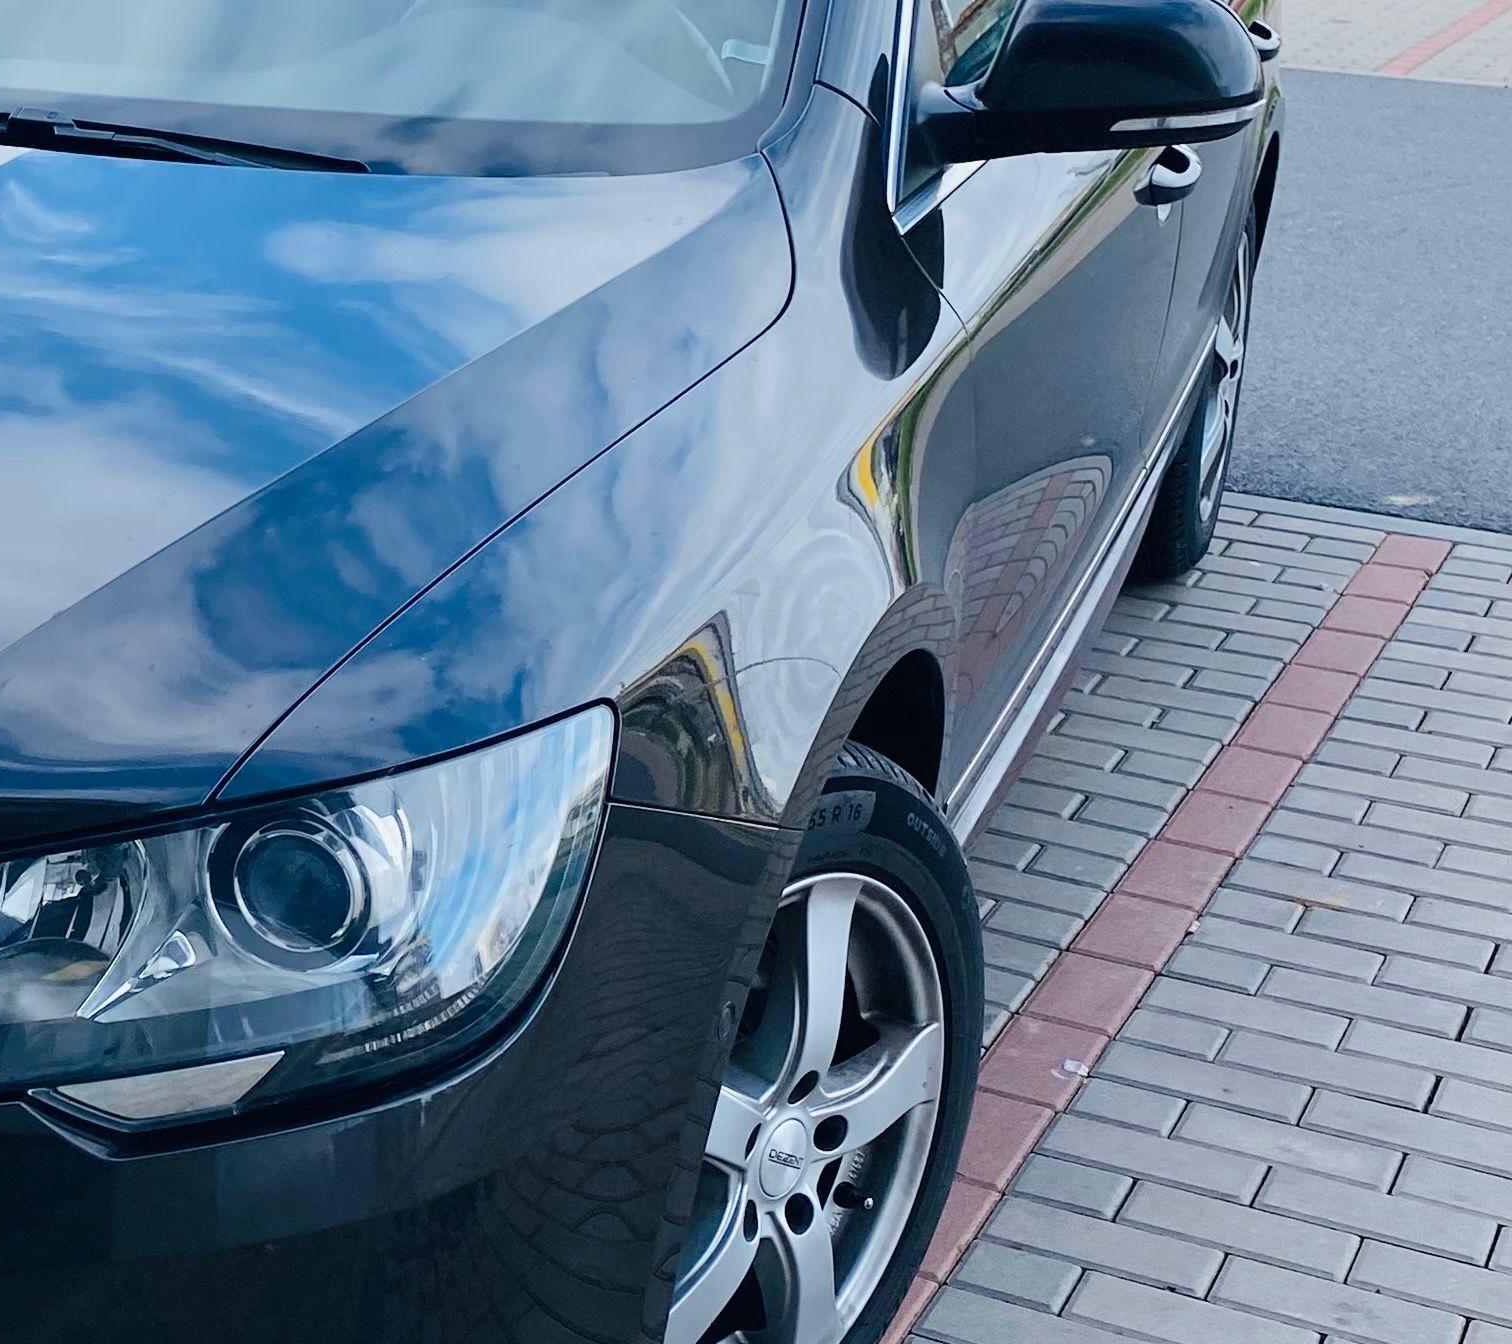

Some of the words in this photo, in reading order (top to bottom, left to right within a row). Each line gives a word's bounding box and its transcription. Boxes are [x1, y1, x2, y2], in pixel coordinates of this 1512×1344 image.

[831, 805, 842, 825] R
[847, 803, 863, 822] 16
[906, 811, 948, 857] OUTSIDE
